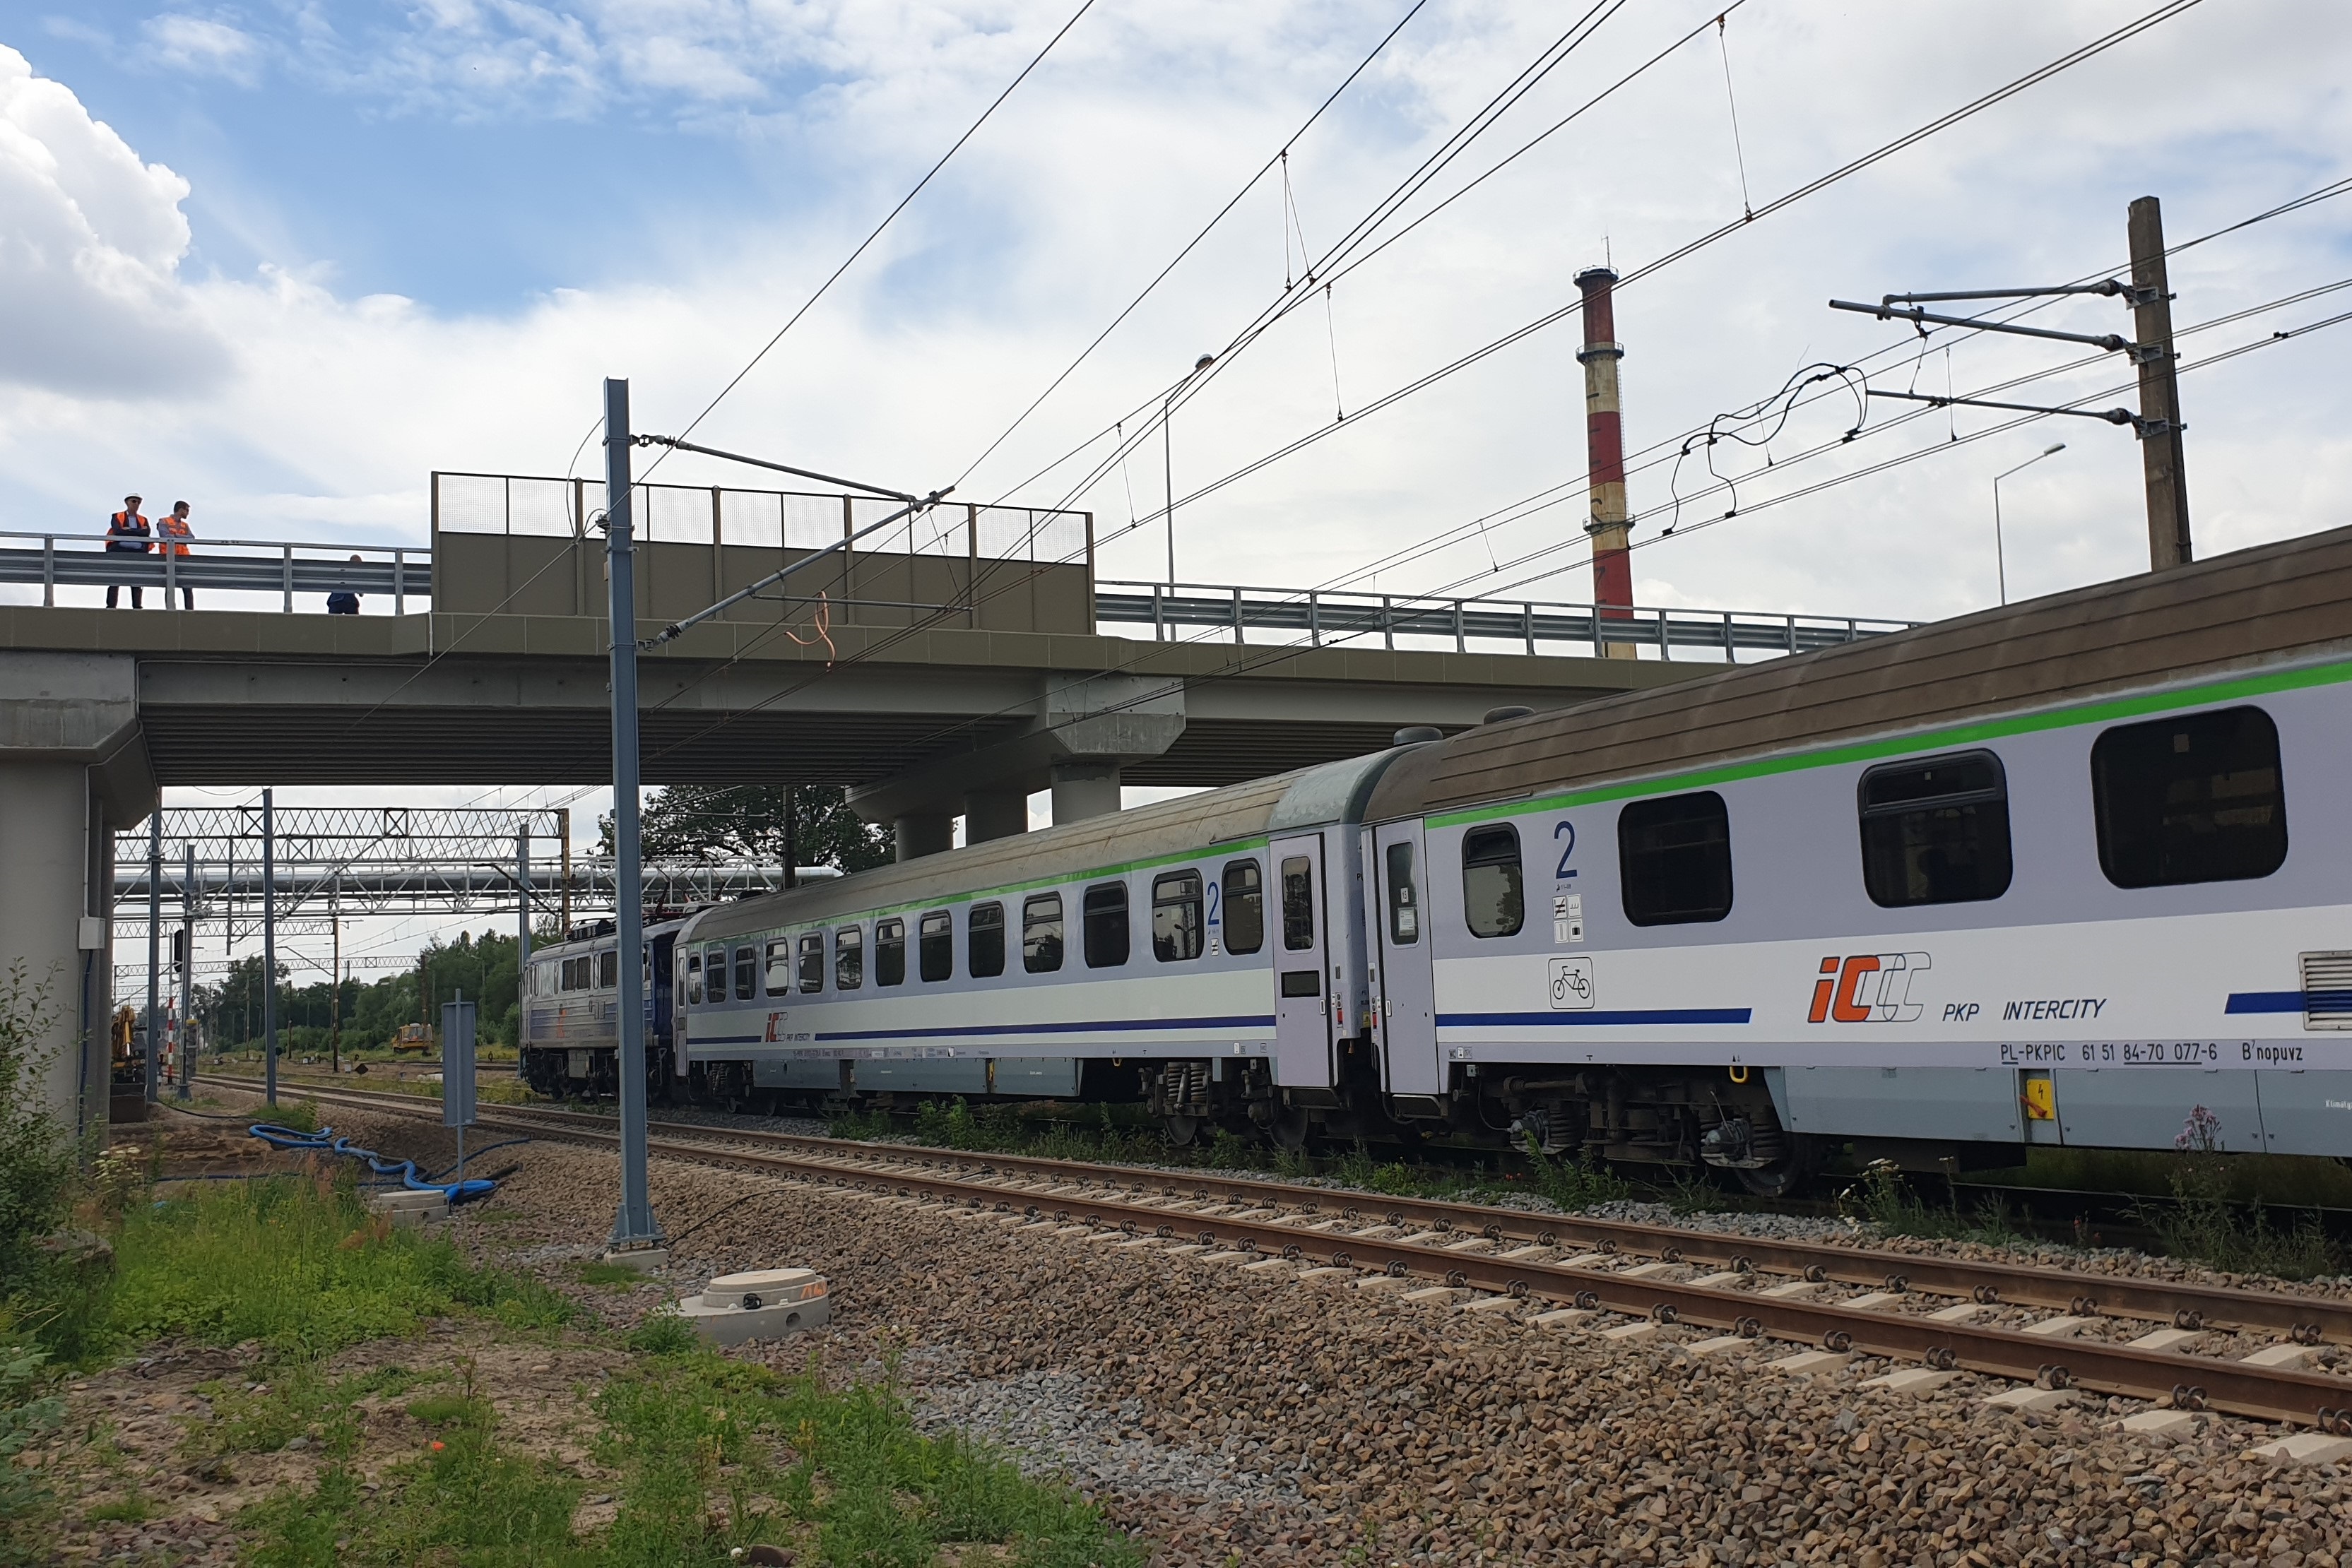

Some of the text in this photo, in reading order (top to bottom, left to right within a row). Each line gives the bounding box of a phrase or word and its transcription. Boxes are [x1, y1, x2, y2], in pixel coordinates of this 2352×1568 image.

[1554, 821, 1578, 879] 2
[1207, 881, 1219, 925] 2
[1942, 998, 2108, 1021] PKP INTERCITY
[2000, 1044, 2065, 1062] PL-PKPIC
[2082, 1044, 2095, 1061] 61
[2102, 1044, 2115, 1061] 51
[2123, 1043, 2165, 1061] 84-70
[2174, 1043, 2218, 1061] 077-6
